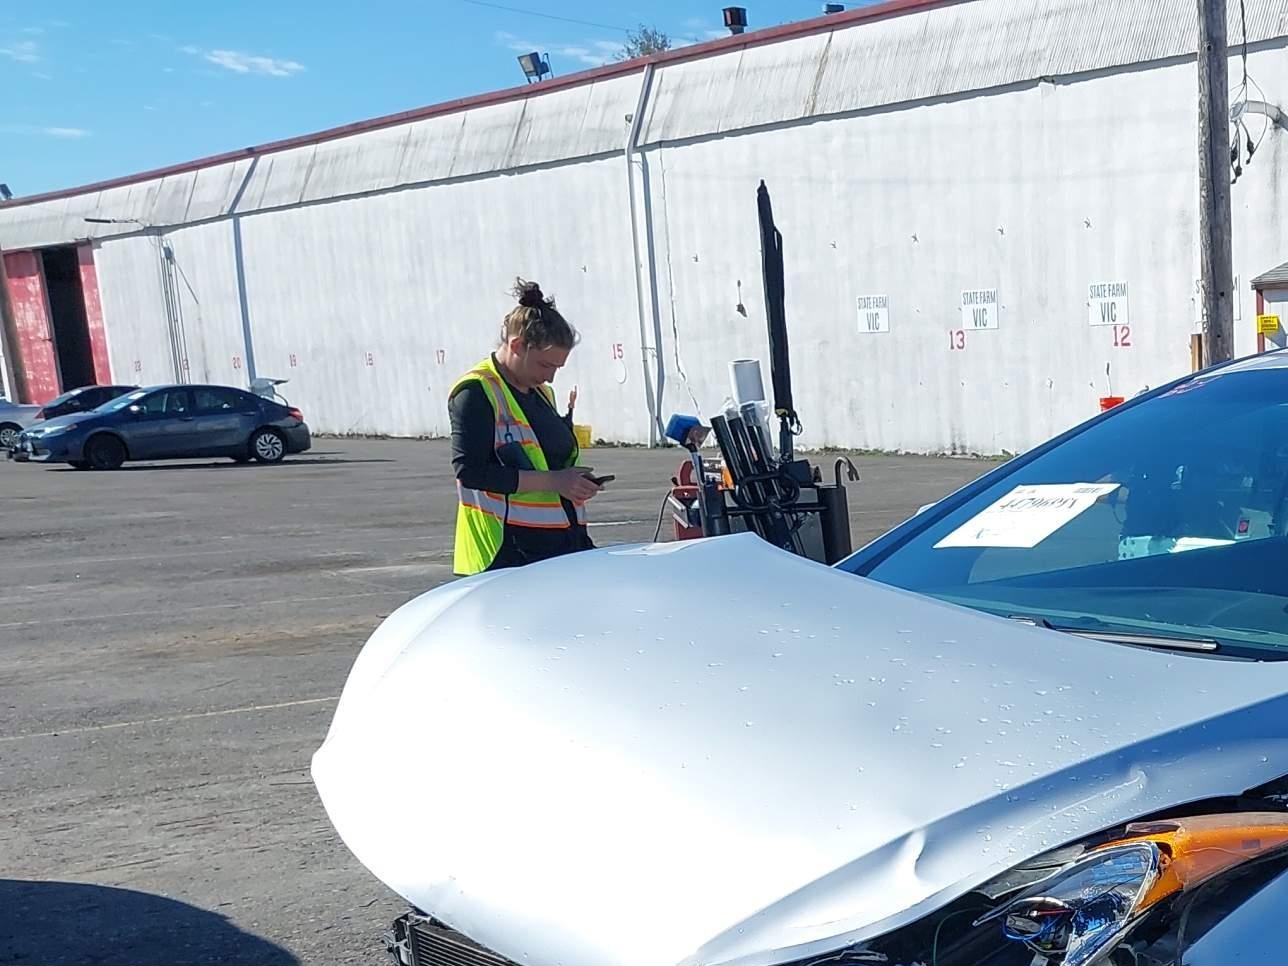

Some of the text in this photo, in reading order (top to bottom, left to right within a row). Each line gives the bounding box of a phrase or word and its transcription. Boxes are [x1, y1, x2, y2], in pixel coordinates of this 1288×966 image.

[962, 290, 996, 306] STATE FARM
[1089, 283, 1127, 299] STATE FARM
[972, 308, 988, 328] VIC
[1099, 301, 1117, 323] VIC
[866, 311, 880, 331] VIC
[949, 330, 966, 350] 13
[1113, 325, 1131, 347] 12
[364, 351, 374, 366] 18
[436, 349, 445, 365] 17
[612, 343, 624, 360] 15
[232, 356, 241, 369] 20
